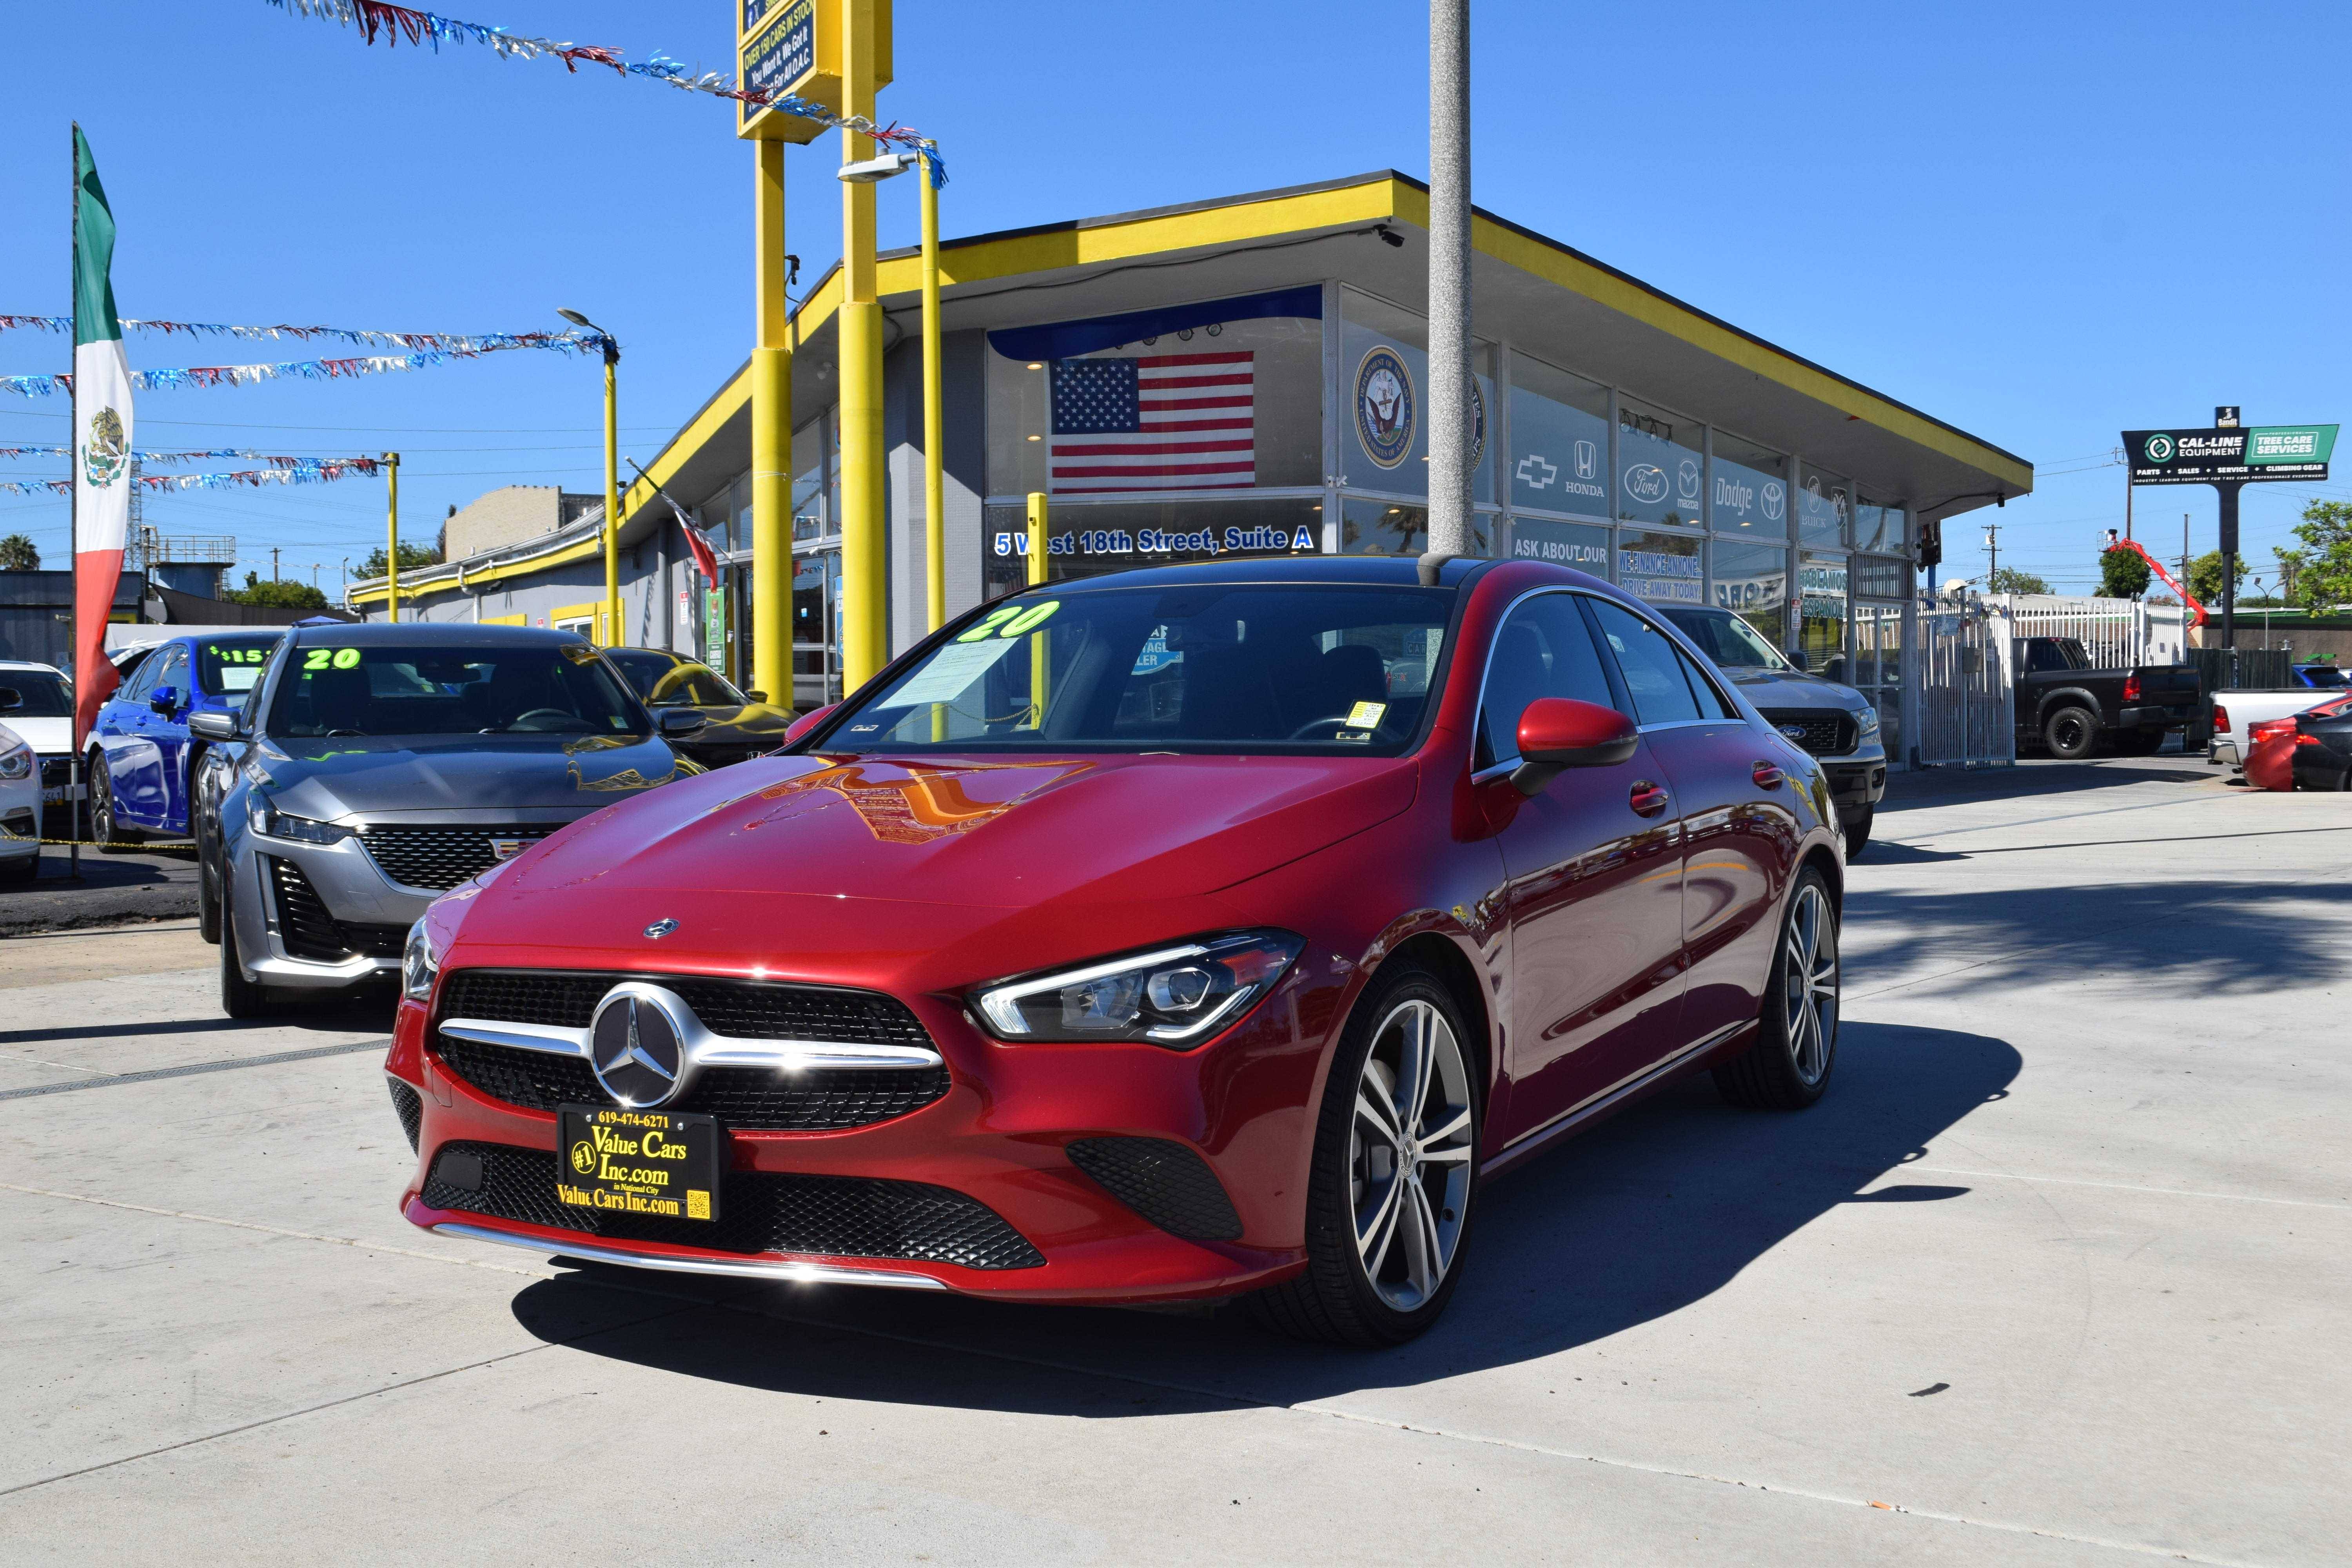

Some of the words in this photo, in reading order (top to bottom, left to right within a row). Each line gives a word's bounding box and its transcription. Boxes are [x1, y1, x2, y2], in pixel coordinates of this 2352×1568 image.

[745, 45, 760, 71] OVER
[760, 36, 770, 56] 150
[770, 20, 786, 48] CARS
[786, 14, 793, 33] IN
[751, 68, 762, 87] You
[762, 54, 776, 78] Want
[782, 41, 791, 61] We
[791, 30, 803, 52] Got
[803, 25, 808, 43] It
[774, 73, 784, 91] For
[784, 63, 792, 83] All
[792, 47, 810, 75] O.A.C.
[1359, 358, 1384, 398] DEPARTMENT
[1386, 359, 1393, 368] OF
[1394, 365, 1402, 382] THE
[1402, 381, 1412, 405] NAVY
[1359, 409, 1372, 443] UNITED
[1370, 440, 1388, 457] STATES
[1388, 448, 1395, 456] OF
[1396, 419, 1411, 453] AMERICA
[2218, 418, 2238, 427] Bandit
[2178, 436, 2243, 448] CAL-LINE
[2179, 447, 2241, 457] EQUIPMENT
[2257, 437, 2282, 446] TREE
[2283, 435, 2314, 445] CARE
[2257, 444, 2312, 455] SERVICES
[1566, 481, 1604, 497] HONDA
[1634, 468, 1659, 496] Ford
[1715, 477, 1753, 516] Dodge
[1801, 515, 1826, 528] BUICK
[994, 532, 1011, 556] 5
[1080, 529, 1132, 554] 18th
[1138, 526, 1219, 556] Street,
[1225, 524, 1289, 549] Suite
[1291, 525, 1314, 549] A
[1515, 538, 1539, 557] ASK
[1542, 541, 1581, 561] ABOUT
[1584, 546, 1606, 563] OUR
[1618, 550, 1631, 572] WE
[1632, 551, 1666, 576] FINANCE
[1622, 577, 1648, 597] DRIVE
[1649, 581, 1672, 598] AWAY
[1674, 583, 1702, 600] TODAY!
[1799, 568, 1848, 592] HABLAMOS
[1802, 595, 1844, 619] ESPAÑOL
[956, 601, 1060, 642] 20
[303, 648, 361, 670] 20
[1782, 727, 1800, 737] Ford
[599, 1111, 669, 1129] 619-474-6271
[591, 1125, 638, 1156] Value
[642, 1131, 687, 1160] Cars
[574, 1145, 594, 1169] #1
[597, 1153, 669, 1185] Inc.com
[621, 1183, 645, 1193] National
[646, 1186, 659, 1196] City
[593, 1188, 624, 1210] Cars
[625, 1192, 679, 1216] Inc.com
